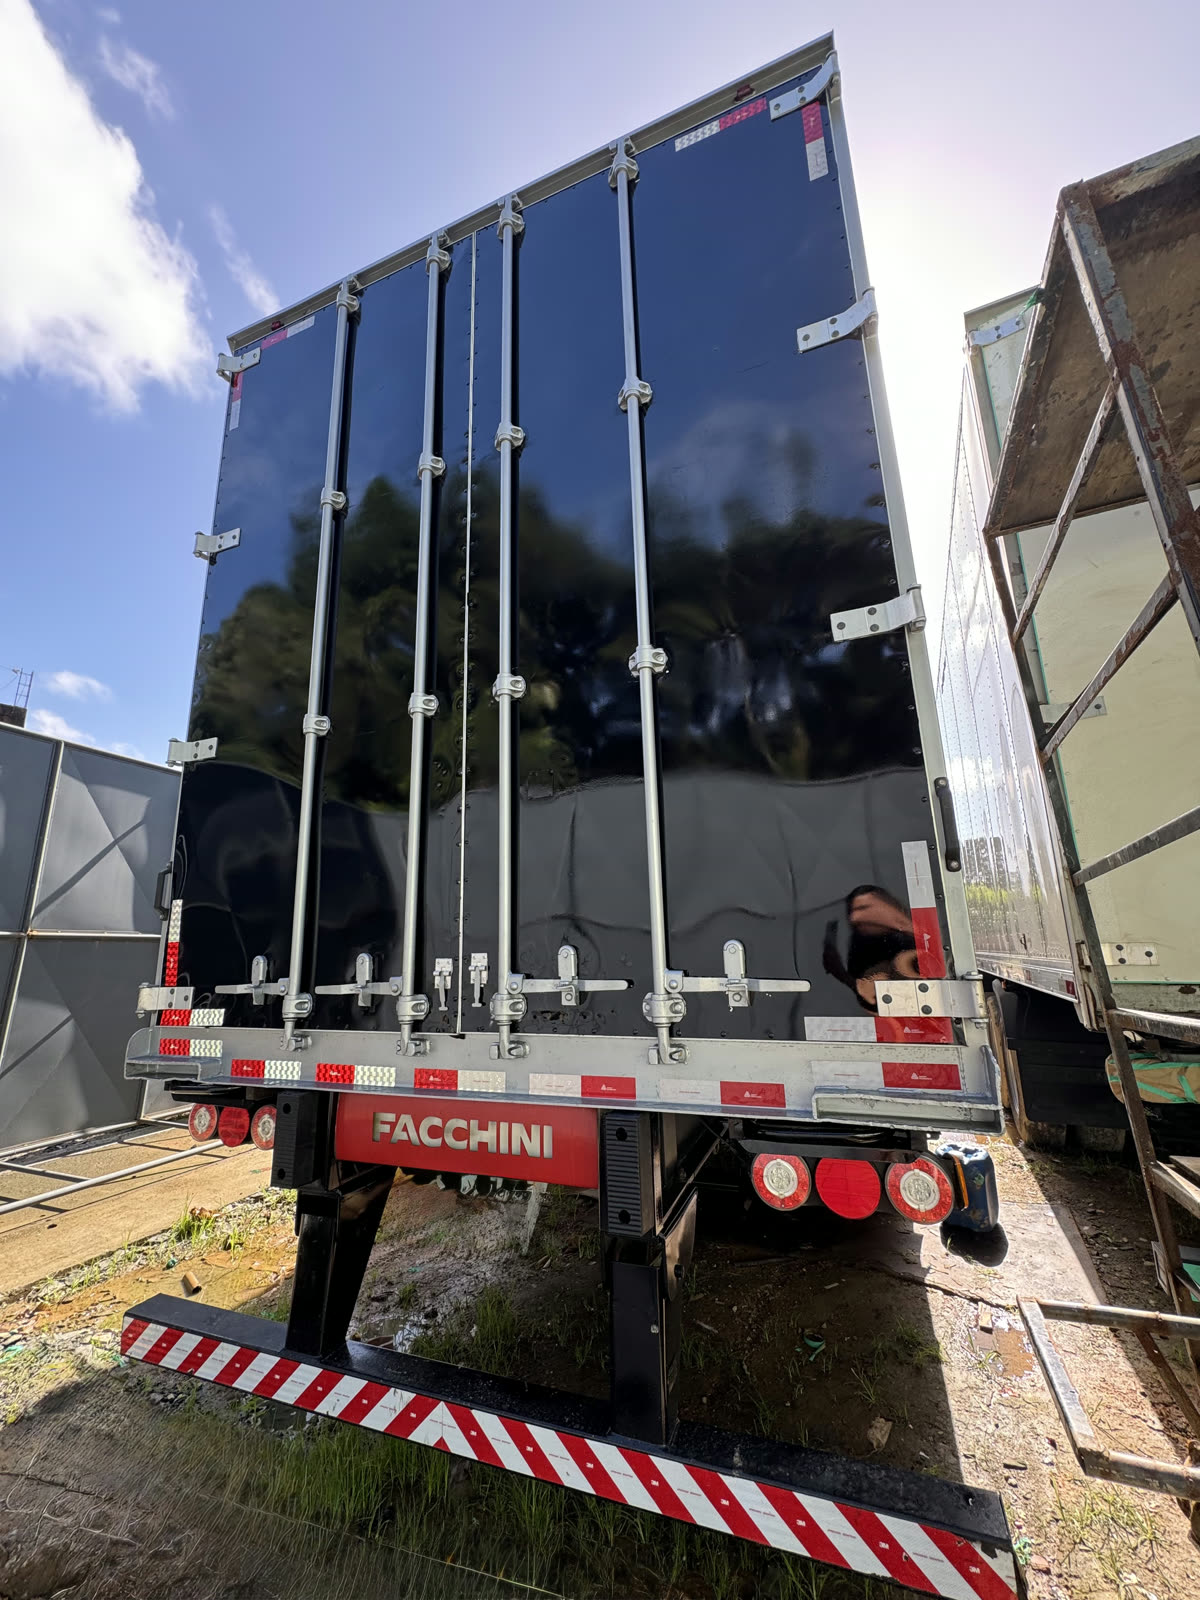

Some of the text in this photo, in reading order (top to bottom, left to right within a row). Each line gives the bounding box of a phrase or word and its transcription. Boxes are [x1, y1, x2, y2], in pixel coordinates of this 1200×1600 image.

[373, 1112, 553, 1159] FACCHINI
[796, 1519, 806, 1527] 3M
[969, 1566, 980, 1574] 3M
